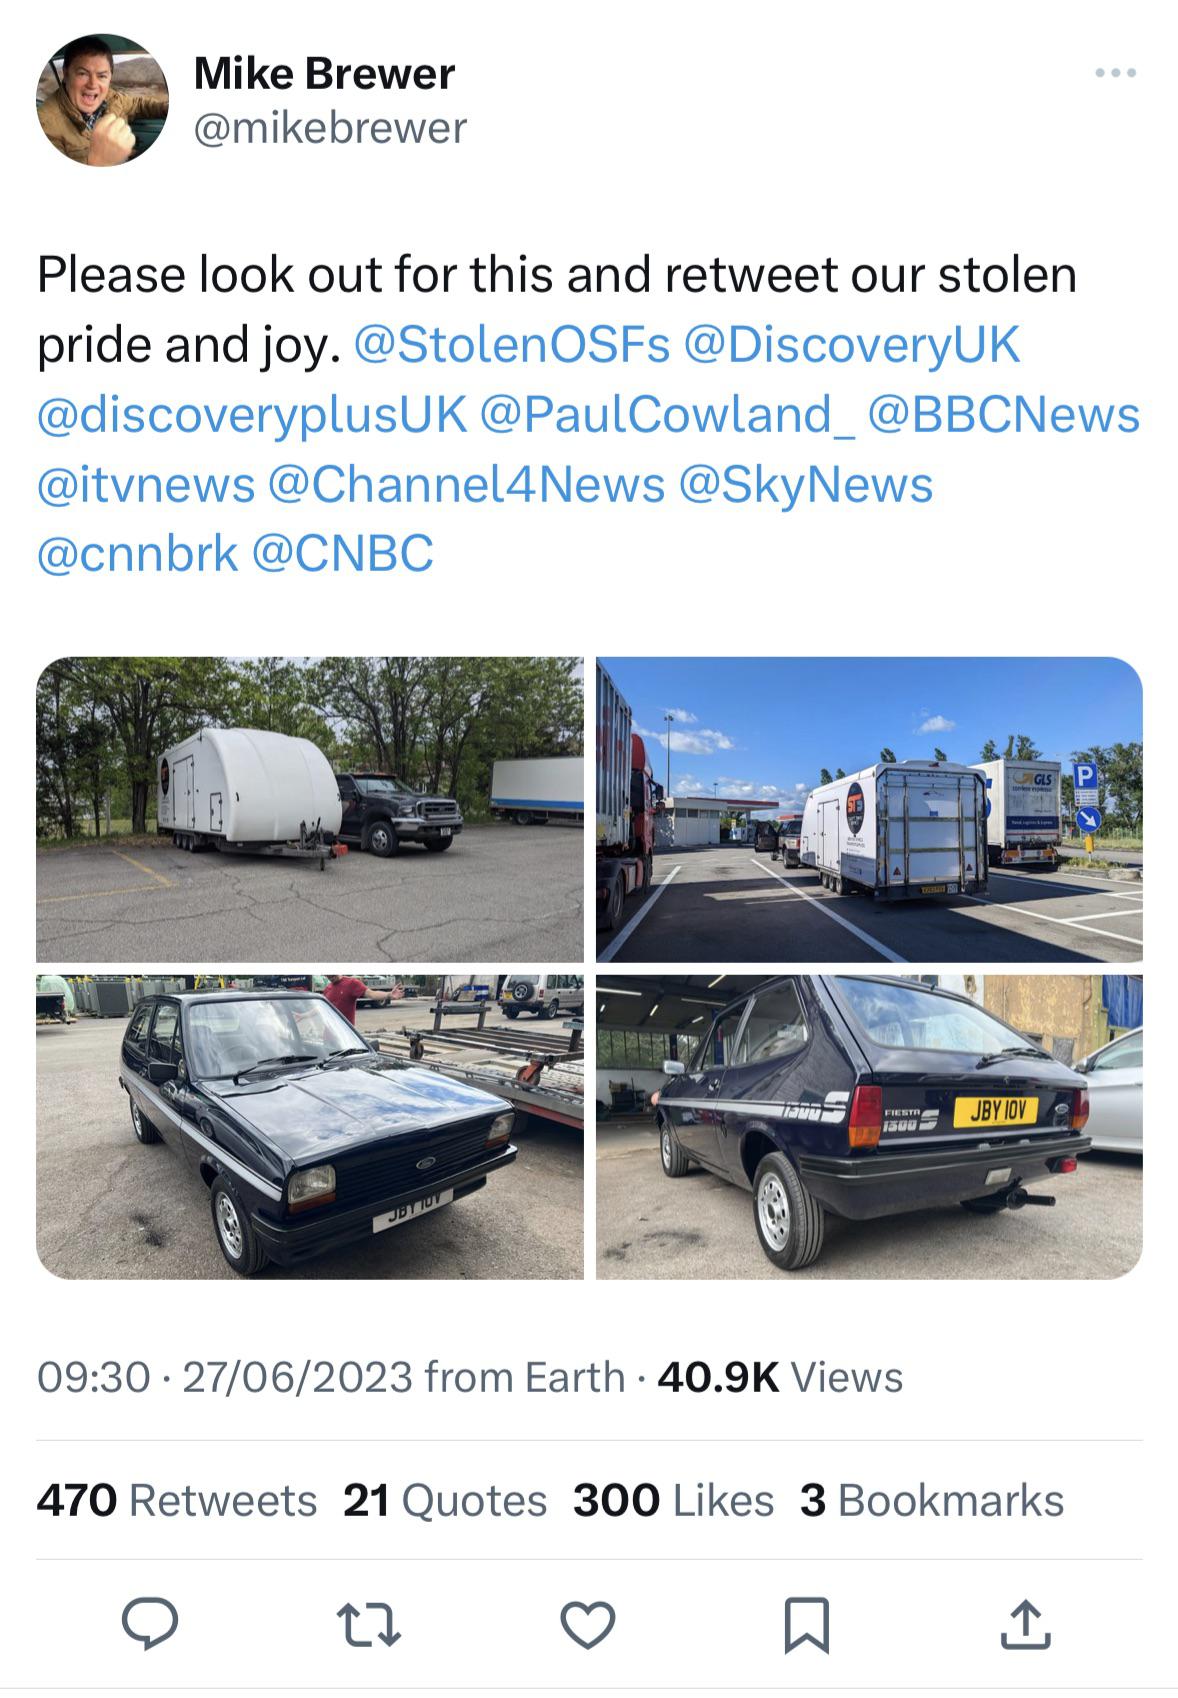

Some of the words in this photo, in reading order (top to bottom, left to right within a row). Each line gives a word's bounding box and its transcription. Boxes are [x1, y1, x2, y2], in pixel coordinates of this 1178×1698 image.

[195, 55, 293, 90] Mike
[306, 56, 456, 90] Brewer
[195, 109, 467, 148] @mikebrewer
[40, 253, 185, 293] Please
[202, 253, 294, 293] look
[309, 257, 382, 293] out
[394, 253, 457, 293] for
[469, 253, 552, 293] this
[568, 253, 649, 293] and
[668, 257, 838, 293] retweet
[852, 265, 925, 293] our
[939, 253, 1075, 293] stolen
[40, 323, 151, 372] pride
[166, 323, 247, 363] and
[260, 324, 339, 373] joy.
[355, 323, 669, 366] @StolenOSFs
[685, 324, 1020, 373] @DiscoveryUK
[38, 393, 467, 443] @discoveryplusUK
[481, 393, 856, 440] @PaulCowland_
[869, 394, 1139, 436] @BBCNews
[38, 464, 254, 507] @itvnews
[269, 464, 664, 507] @Channel4News
[680, 464, 932, 512] @SkyNews
[38, 532, 238, 576] @cnnbrk
[253, 533, 433, 576] @CNBC
[1034, 773, 1053, 786] GLS
[1077, 766, 1094, 787] P
[884, 1109, 921, 1117] FIESTA
[971, 1100, 1002, 1121] JBY
[38, 1361, 150, 1393] 09:30
[184, 1360, 412, 1397] 27/06/2023
[425, 1360, 512, 1392] from
[527, 1360, 624, 1393] Earth
[658, 1361, 780, 1393] 40.9K
[791, 1360, 902, 1393] Views
[37, 1483, 117, 1517] 470
[132, 1484, 316, 1517] Retweets
[344, 1483, 386, 1516] 21
[403, 1483, 546, 1522] Quotes
[574, 1483, 660, 1517] 300
[676, 1482, 773, 1517] Likes
[801, 1483, 825, 1517] 3
[840, 1482, 1063, 1517] Bookmarks
